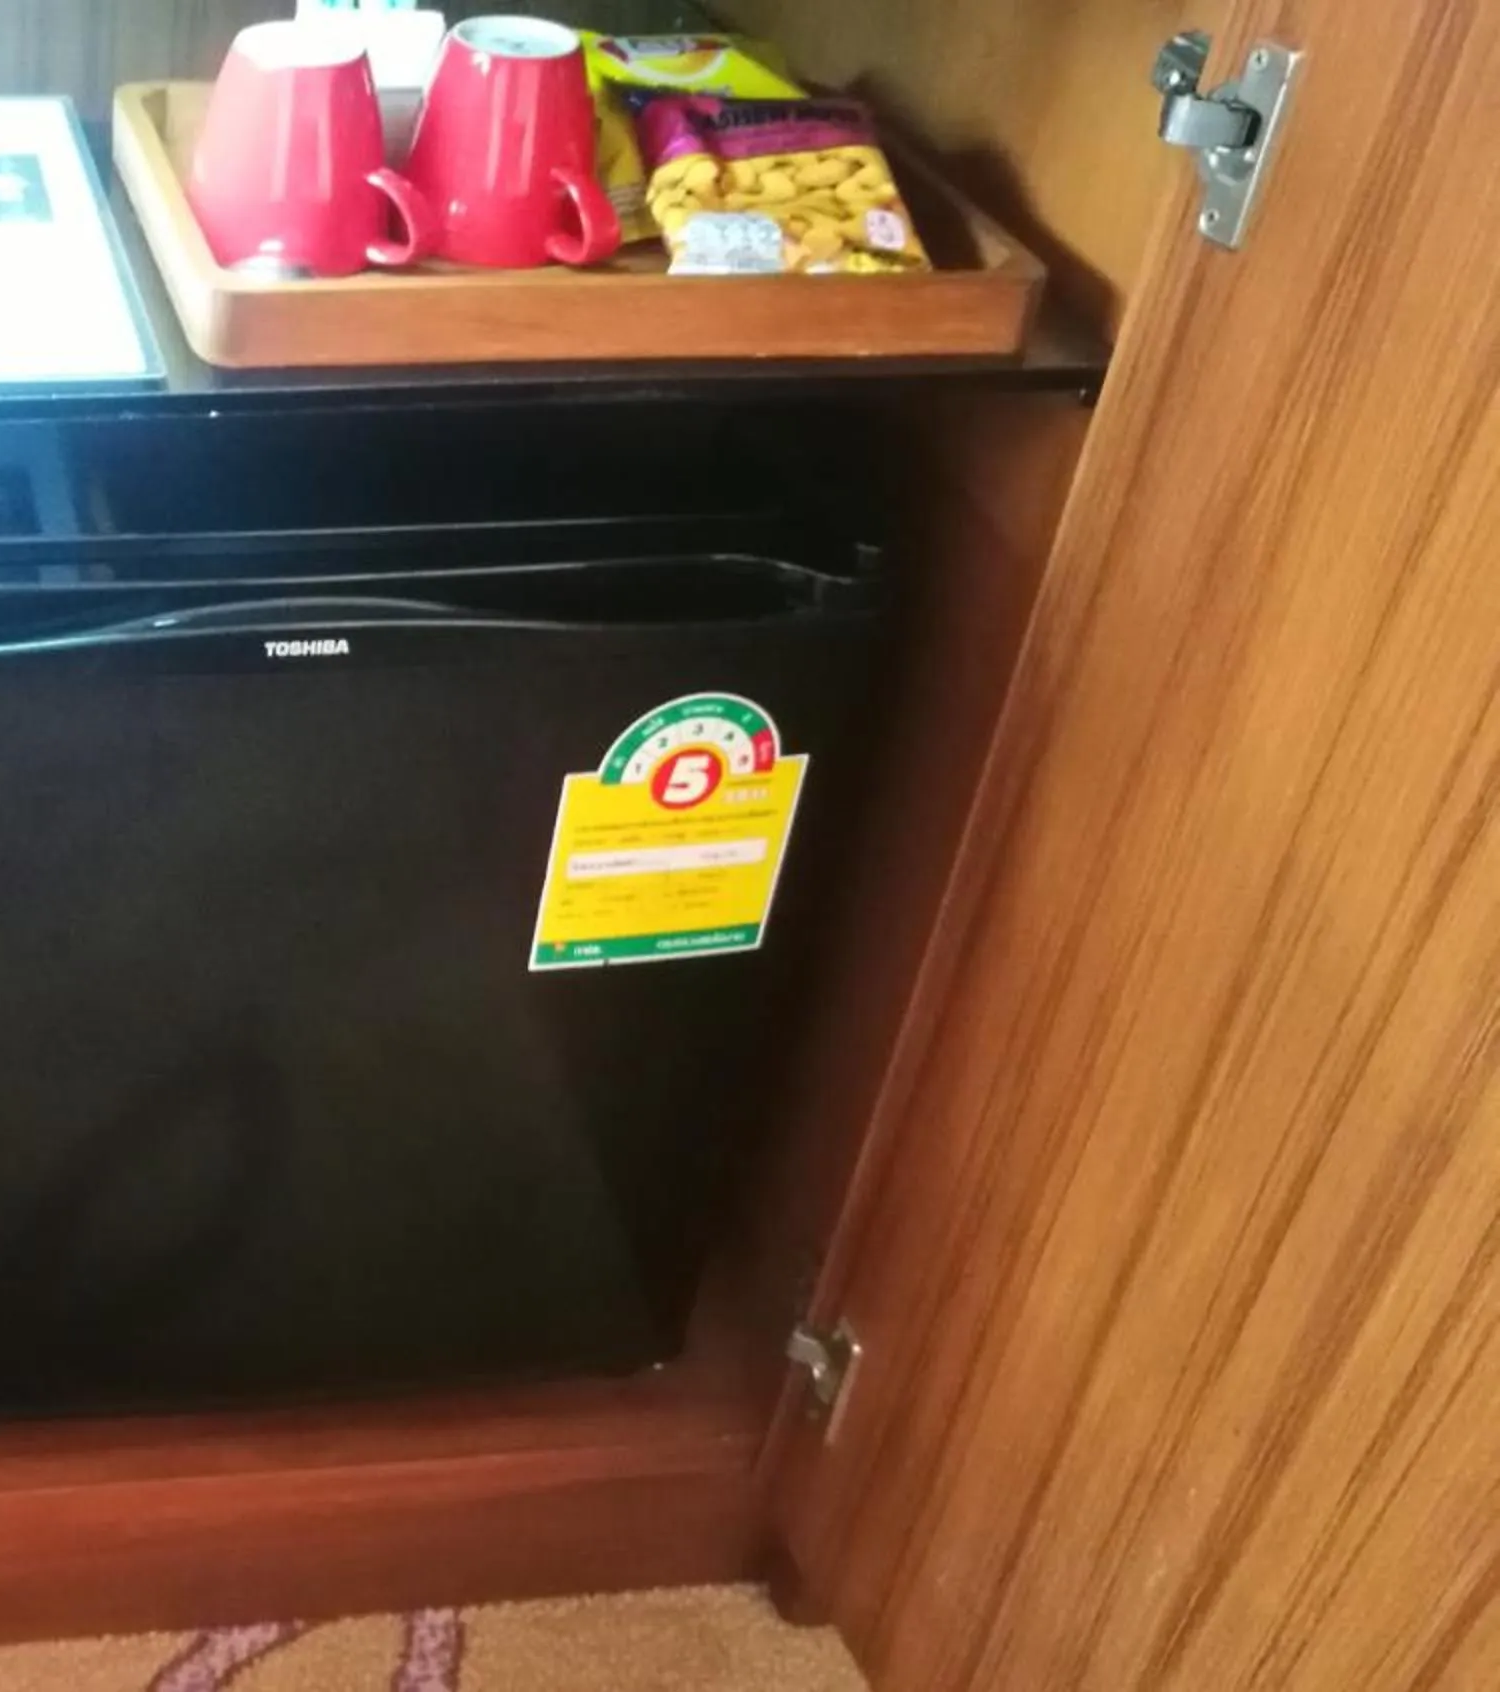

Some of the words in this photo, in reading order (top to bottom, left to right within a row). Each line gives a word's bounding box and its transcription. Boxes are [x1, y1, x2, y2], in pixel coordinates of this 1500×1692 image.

[264, 638, 350, 657] TOSHIBA
[692, 722, 704, 736] 3
[662, 754, 711, 804] 5
